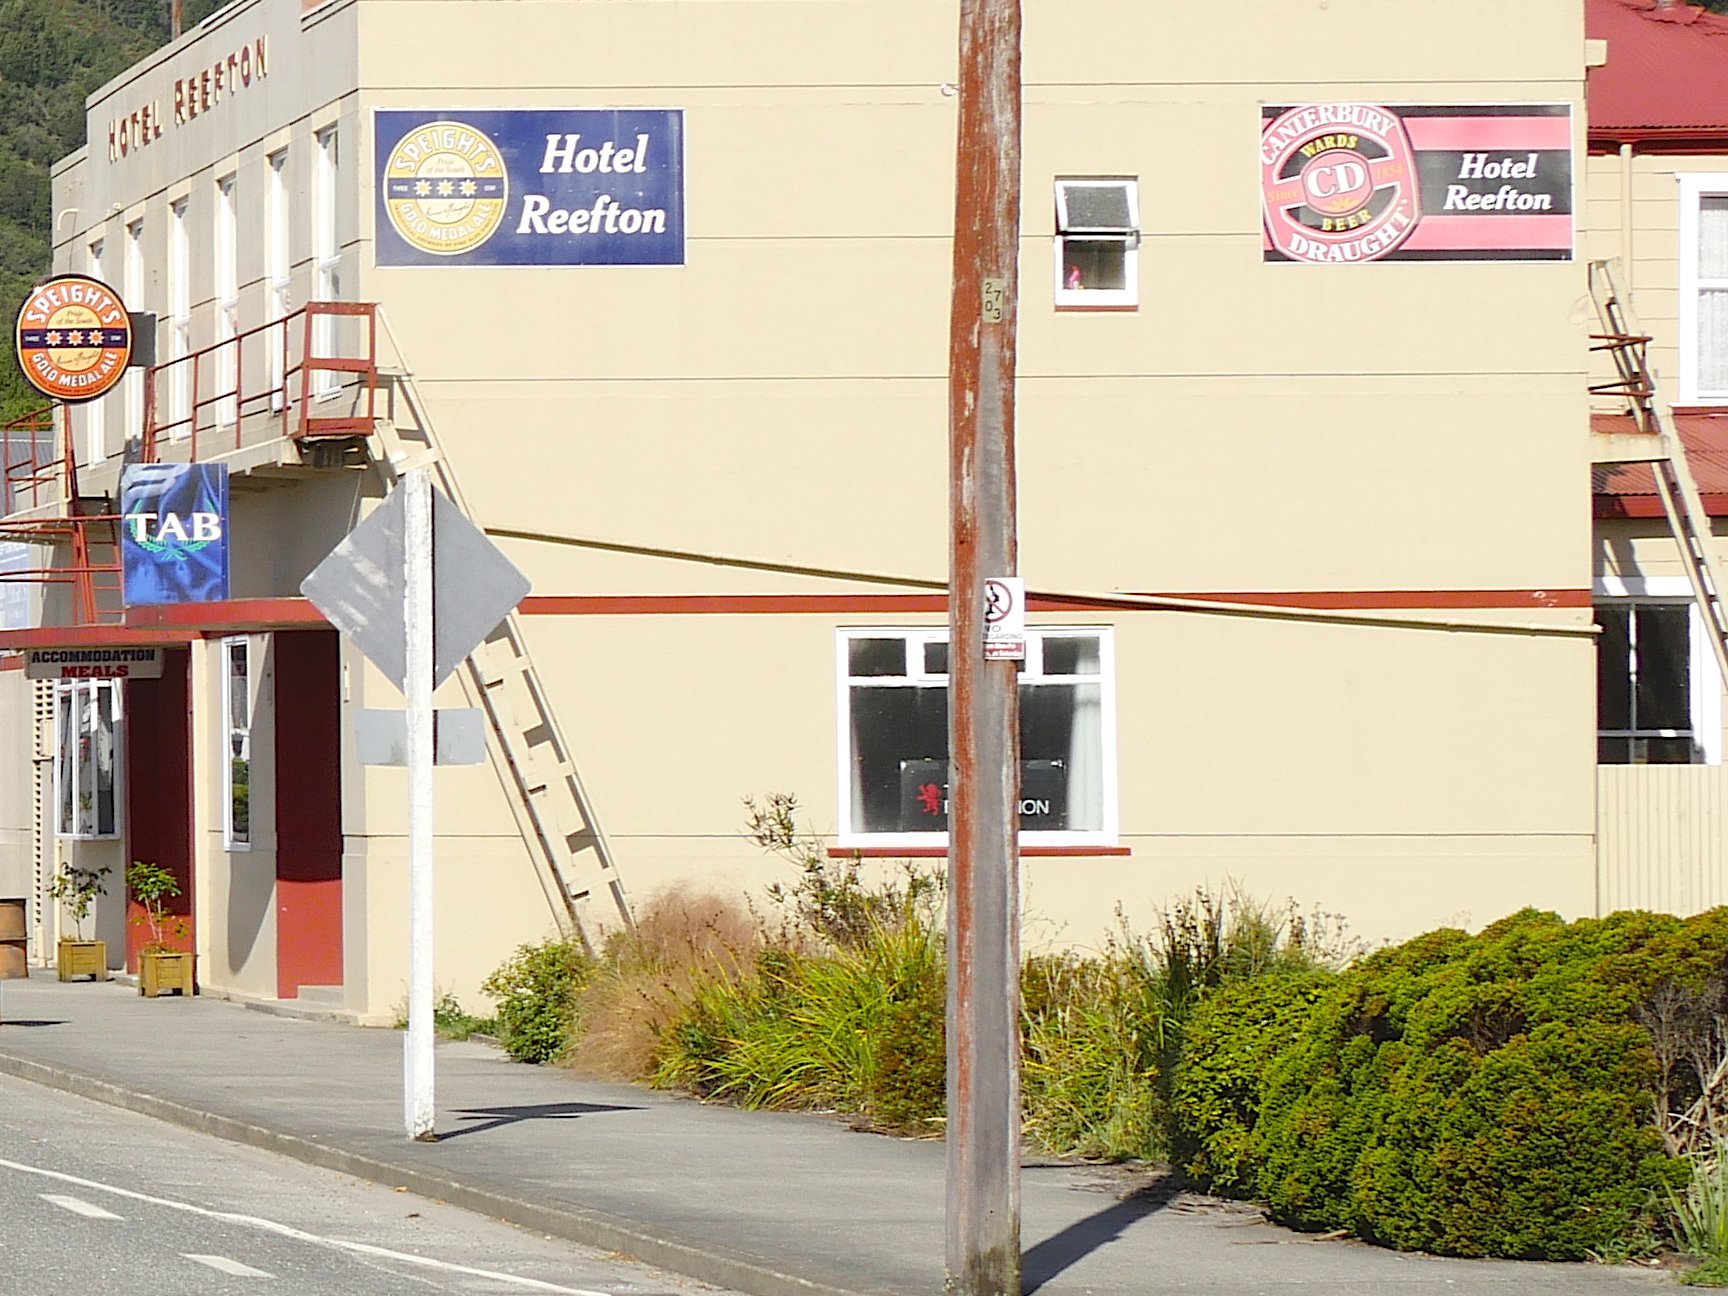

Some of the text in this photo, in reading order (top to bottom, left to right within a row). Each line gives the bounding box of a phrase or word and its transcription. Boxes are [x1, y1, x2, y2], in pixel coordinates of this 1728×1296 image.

[109, 34, 268, 164] HOTEL REEFTON
[1261, 105, 1395, 165] CANTERBURY
[1300, 134, 1358, 158] WARDS
[539, 134, 649, 173] Hotel
[1458, 153, 1538, 179] Hotel
[1306, 162, 1365, 198] CD
[1443, 184, 1552, 210] Reefton
[429, 223, 475, 240] MEDAL
[472, 203, 491, 226] ALE
[516, 194, 666, 234] Reefton
[1322, 209, 1372, 232] BEER
[1288, 206, 1410, 261] DRAUGHT
[32, 352, 59, 382] GOLD
[58, 371, 102, 387] MEDAL
[100, 351, 118, 374] ALE
[125, 512, 222, 542] TAB
[32, 649, 155, 663] ACCOMMODATION
[61, 664, 129, 678] MEALS
